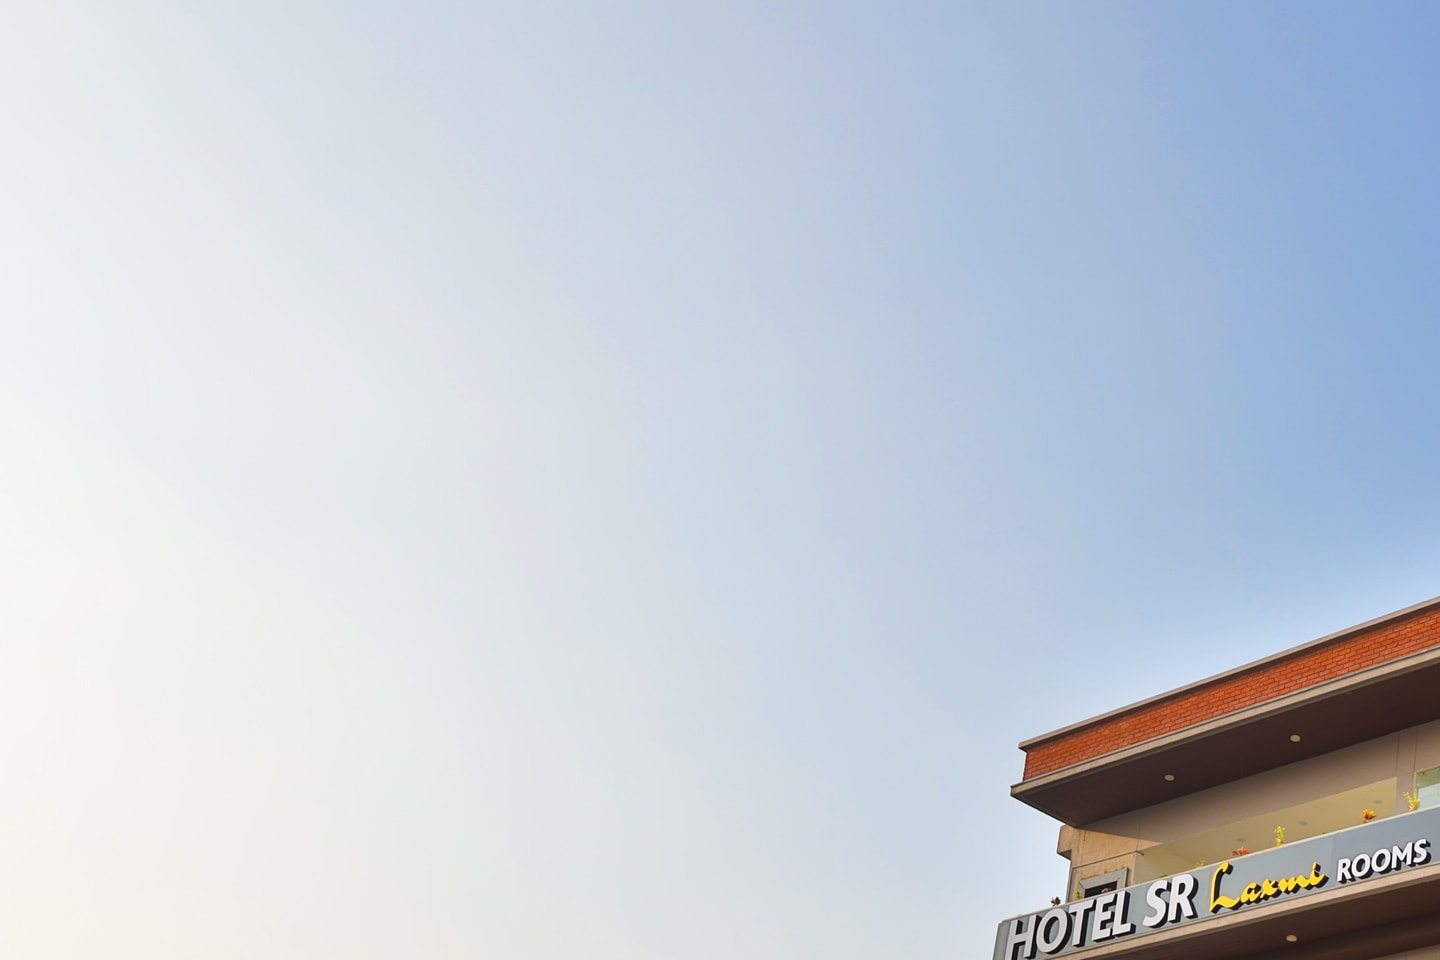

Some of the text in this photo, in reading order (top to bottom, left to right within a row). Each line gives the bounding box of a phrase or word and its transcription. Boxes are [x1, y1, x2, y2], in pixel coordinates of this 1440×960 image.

[1142, 873, 1198, 928] SR
[1208, 862, 1328, 913] Laxmi
[1337, 839, 1430, 882] ROOMS
